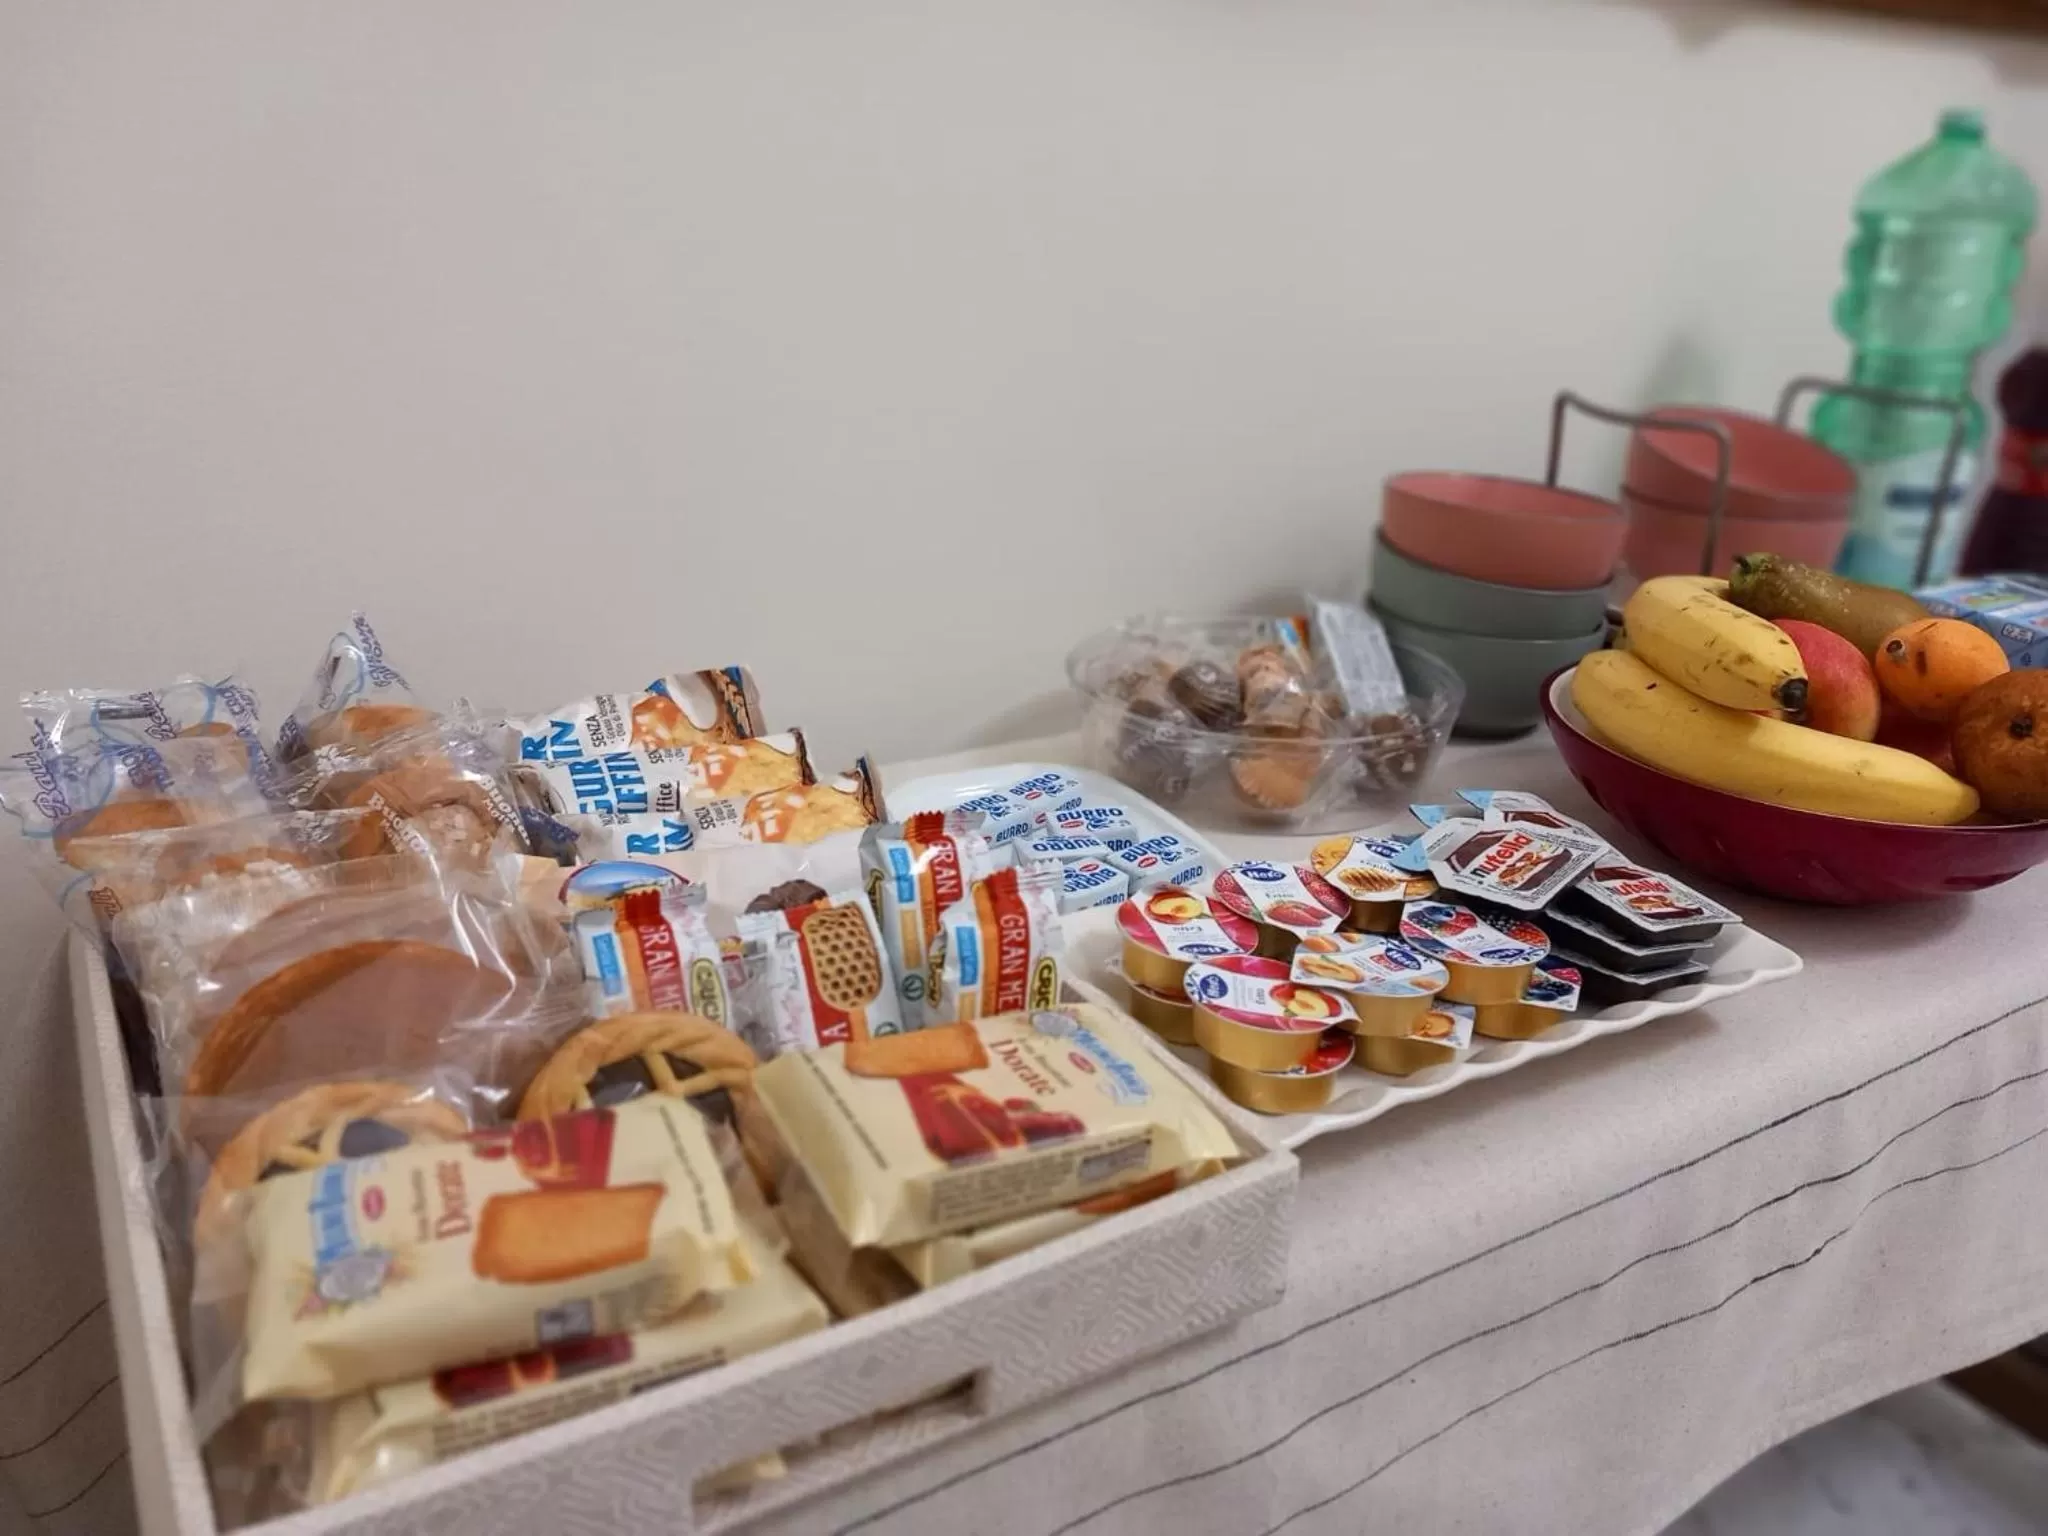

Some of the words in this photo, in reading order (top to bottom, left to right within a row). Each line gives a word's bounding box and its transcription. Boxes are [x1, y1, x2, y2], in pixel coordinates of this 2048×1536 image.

[585, 714, 607, 748] SENZA
[1009, 773, 1061, 796] BURRO
[1056, 807, 1124, 823] BURRO
[996, 822, 1030, 842] BURRO
[1121, 835, 1179, 862] BURRO
[1470, 832, 1534, 878] nutella
[1001, 914, 1027, 974] GRAN
